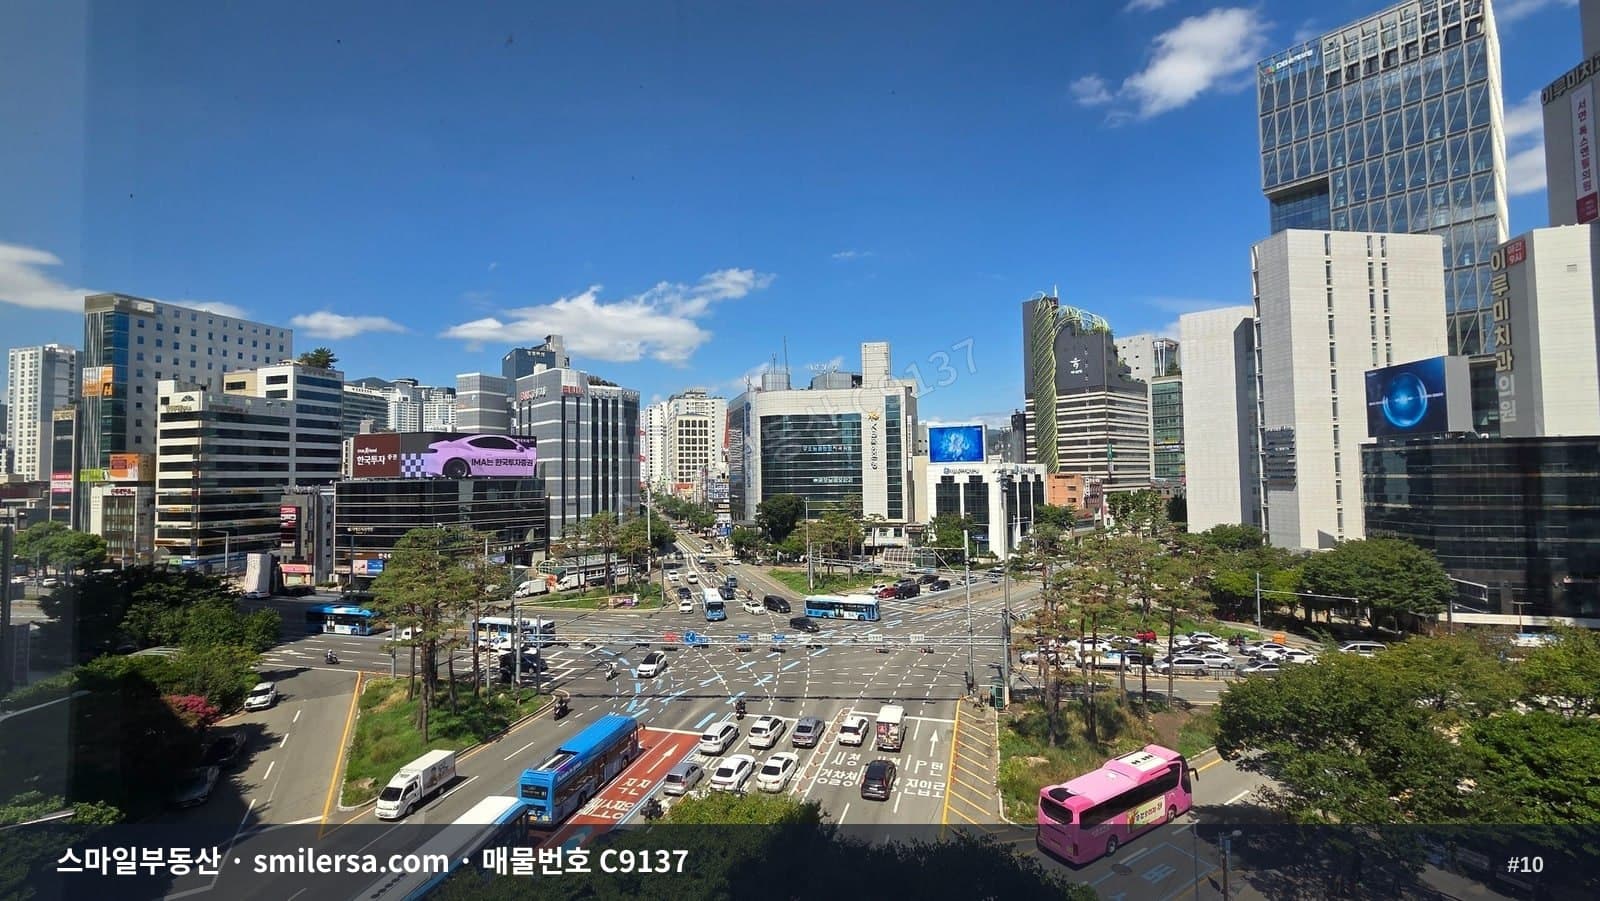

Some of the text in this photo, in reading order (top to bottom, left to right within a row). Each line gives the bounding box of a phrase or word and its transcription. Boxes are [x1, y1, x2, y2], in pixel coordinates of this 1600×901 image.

[1490, 249, 1517, 422] 이루미치과의원
[356, 455, 385, 466] 한국투자
[471, 458, 534, 467] IMA는 한국투자증권
[817, 768, 858, 787] 경찰청
[904, 778, 946, 798] 진입로
